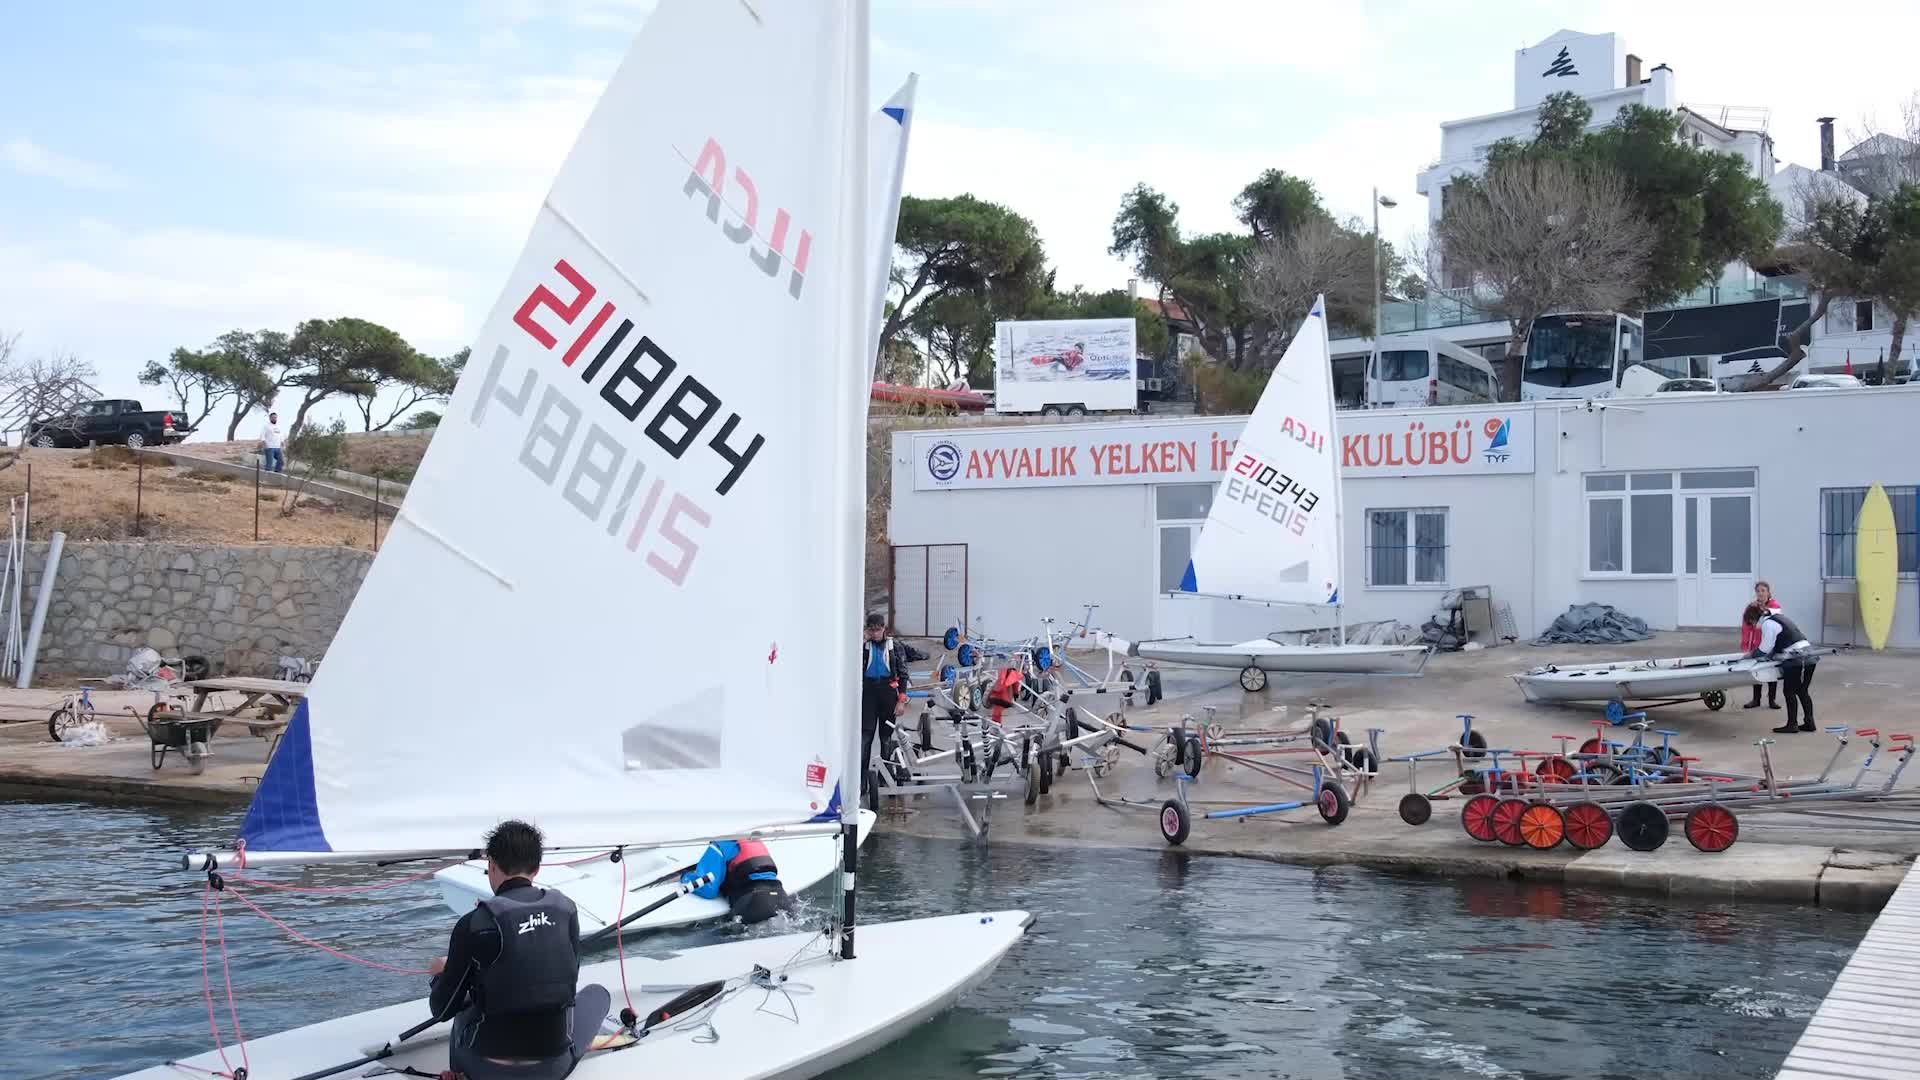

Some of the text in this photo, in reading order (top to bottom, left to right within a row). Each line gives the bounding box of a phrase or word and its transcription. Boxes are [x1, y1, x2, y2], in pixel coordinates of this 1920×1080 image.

[512, 258, 766, 495] 211884
[965, 446, 1077, 479] AYVALIK
[1090, 441, 1197, 475] YELKEN
[1342, 420, 1473, 467] KULÜBÜ
[1484, 454, 1511, 464] TYF
[1234, 454, 1319, 513] 210343
